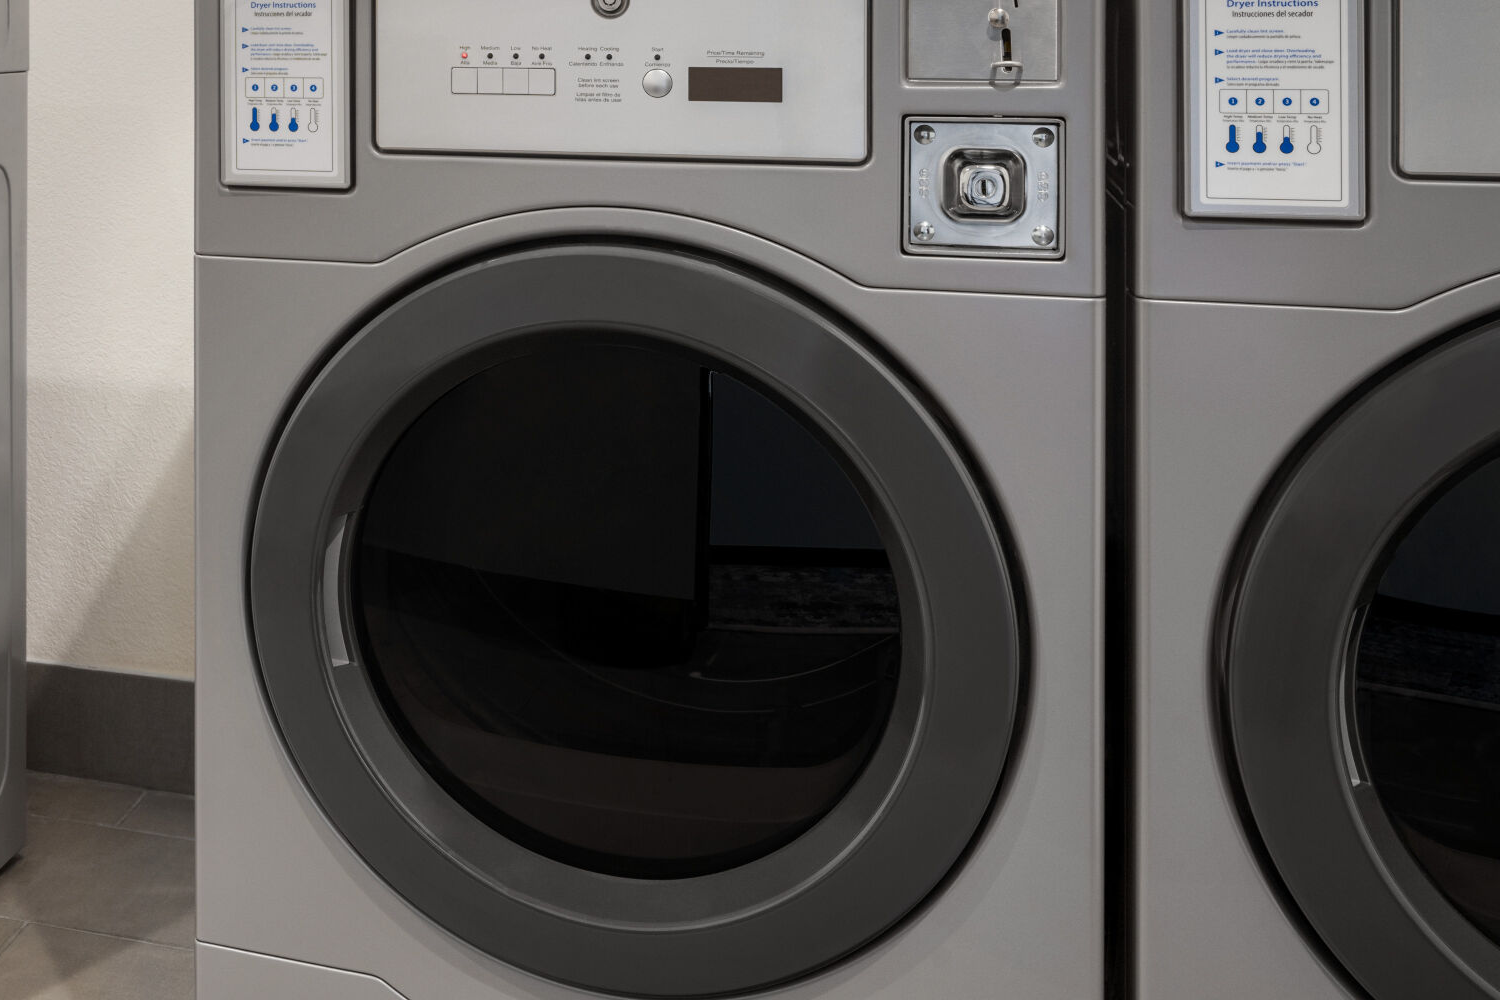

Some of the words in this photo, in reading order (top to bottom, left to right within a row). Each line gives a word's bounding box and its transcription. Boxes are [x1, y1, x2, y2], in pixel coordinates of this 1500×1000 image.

[250, 1, 271, 10] Dryer
[272, 1, 317, 9] Instructions
[1226, 0, 1255, 9] Dryer
[1232, 10, 1275, 18] Instrucciones
[1276, 10, 1287, 18] del
[1288, 10, 1313, 18] secador
